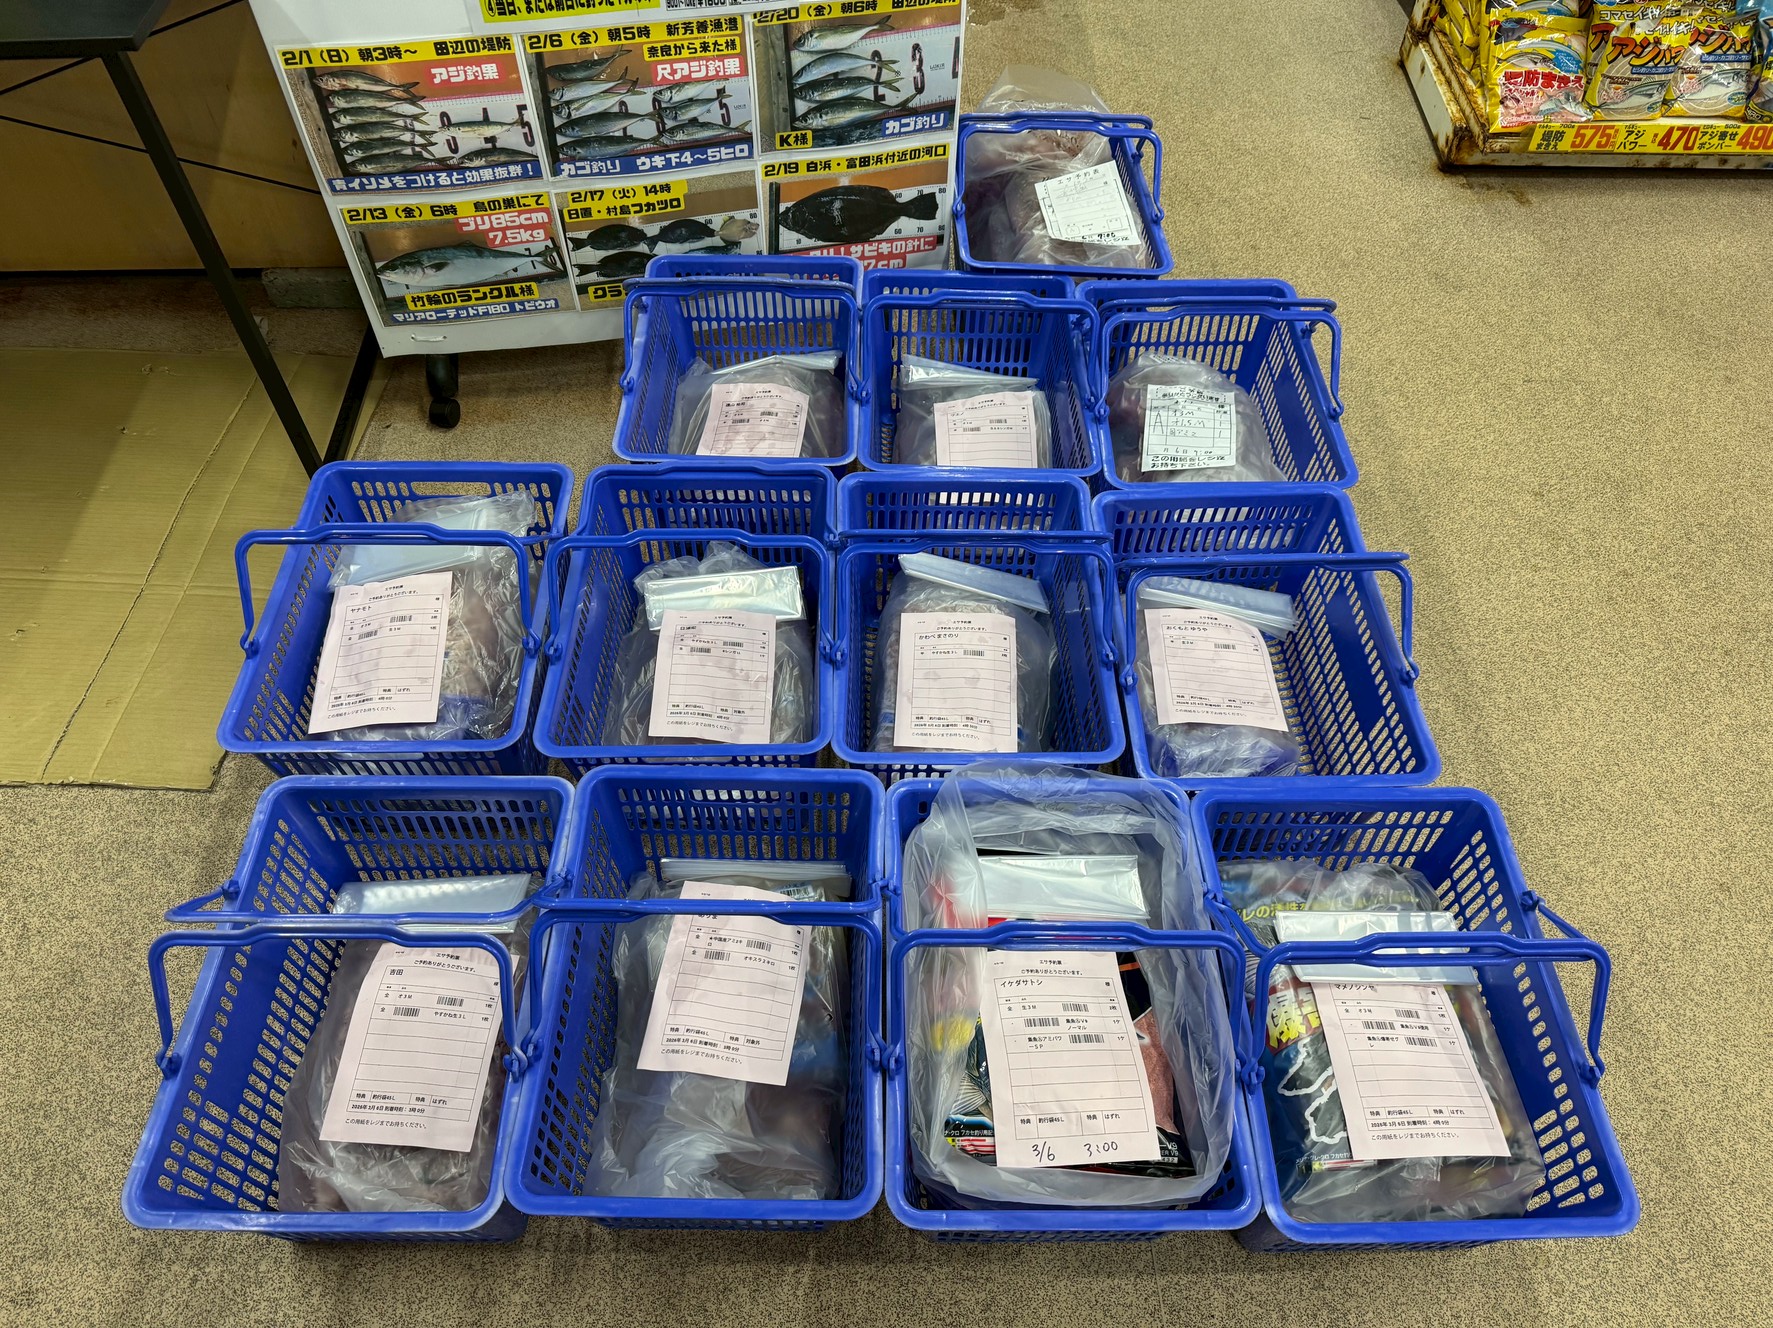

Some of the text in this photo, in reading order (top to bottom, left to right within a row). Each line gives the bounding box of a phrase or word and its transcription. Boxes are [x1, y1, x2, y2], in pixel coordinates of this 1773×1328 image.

[841, 0, 878, 15] 朝6時
[528, 30, 599, 51] 2/6（金）
[608, 26, 651, 43] 朝5時
[281, 48, 351, 66] 2/1（日）
[433, 36, 512, 57] 田辺の堤防
[646, 38, 738, 59] 奈良から来た様
[430, 62, 501, 85] アジ釣果
[656, 57, 741, 82] 尺アジ釣果
[885, 112, 944, 135] カゴ釣り
[779, 132, 809, 147] K様
[1541, 129, 1567, 142] 堤防
[1569, 124, 1616, 149] 575
[1623, 129, 1647, 141] アジ
[1657, 125, 1701, 151] 470
[1698, 130, 1739, 141] アジ寄せ
[1736, 125, 1773, 151] 490
[1535, 142, 1559, 151] まきえ
[1616, 141, 1648, 151] パワー
[560, 158, 621, 177] カゴ釣り
[764, 144, 947, 178] 2/19 白浜・富田浜付近の河口
[331, 162, 535, 191] 青イソメをつけると効果抜群！
[570, 182, 672, 204] 2/17（火） 14時
[347, 205, 423, 222] 2/13（金）
[431, 204, 458, 217] 6時
[458, 210, 549, 231] ブリ85cm
[488, 228, 545, 246] 7.5kg
[410, 284, 535, 308] 竹輪のランクル様
[515, 299, 556, 311] トビウオ
[413, 960, 476, 973] ご予約ありがとうございます。
[1001, 979, 1043, 988] イケダサトシ
[661, 1048, 742, 1065] この用紙をレジまでお持ちください。
[345, 1118, 427, 1130] この用紙をレジまでお持ちください。
[1371, 1132, 1460, 1141] この用紙をレジまでお持ちください。
[1031, 1140, 1119, 1163] 3/6 3:00
